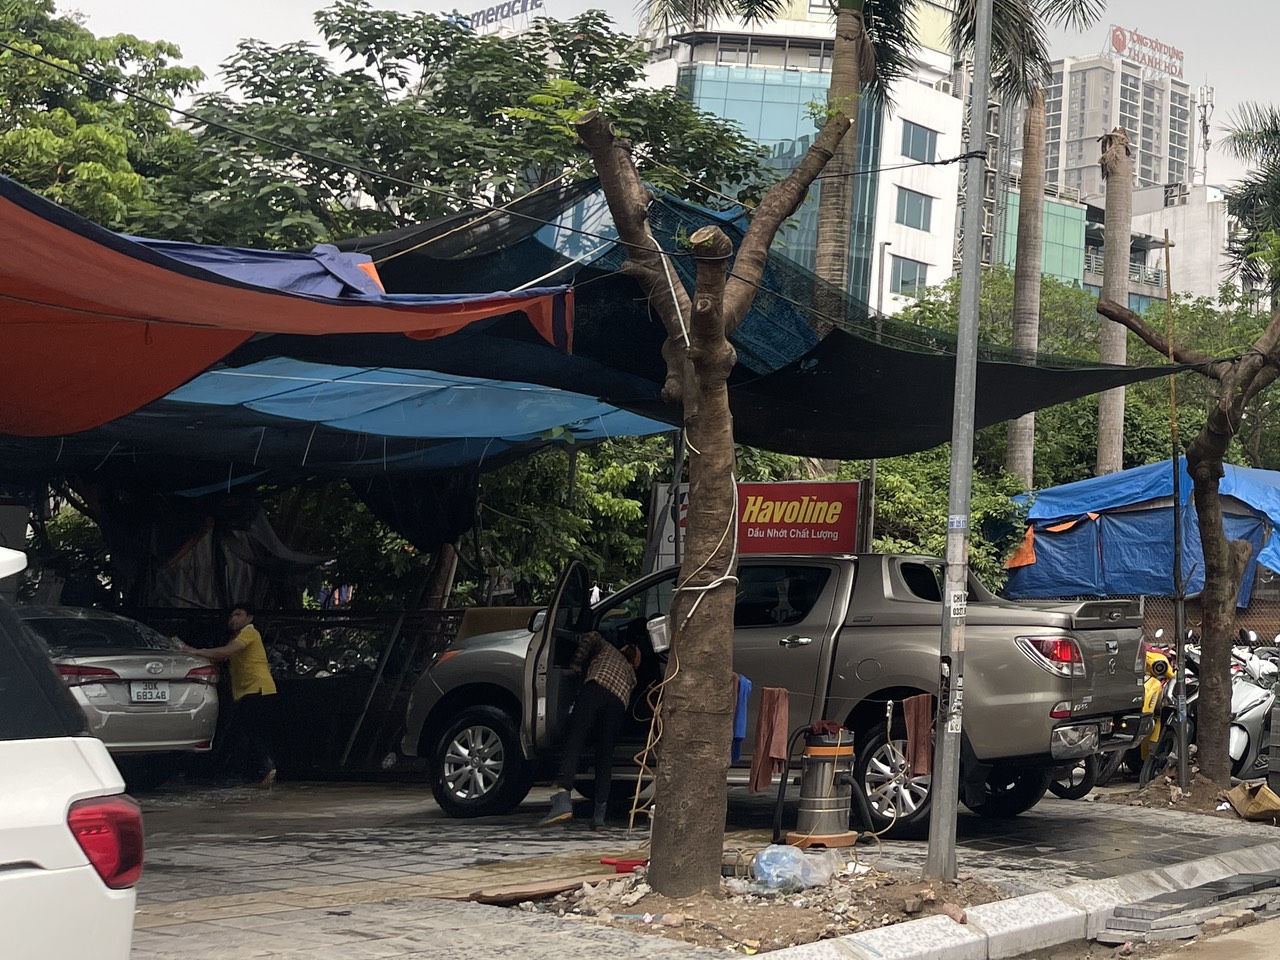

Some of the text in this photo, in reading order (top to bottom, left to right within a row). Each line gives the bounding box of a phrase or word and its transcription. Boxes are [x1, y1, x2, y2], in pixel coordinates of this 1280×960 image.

[1128, 46, 1161, 70] THANH
[741, 496, 842, 524] Havoline
[789, 527, 810, 539] Chất
[811, 528, 838, 541] Lượng
[136, 691, 167, 700] 683.48
